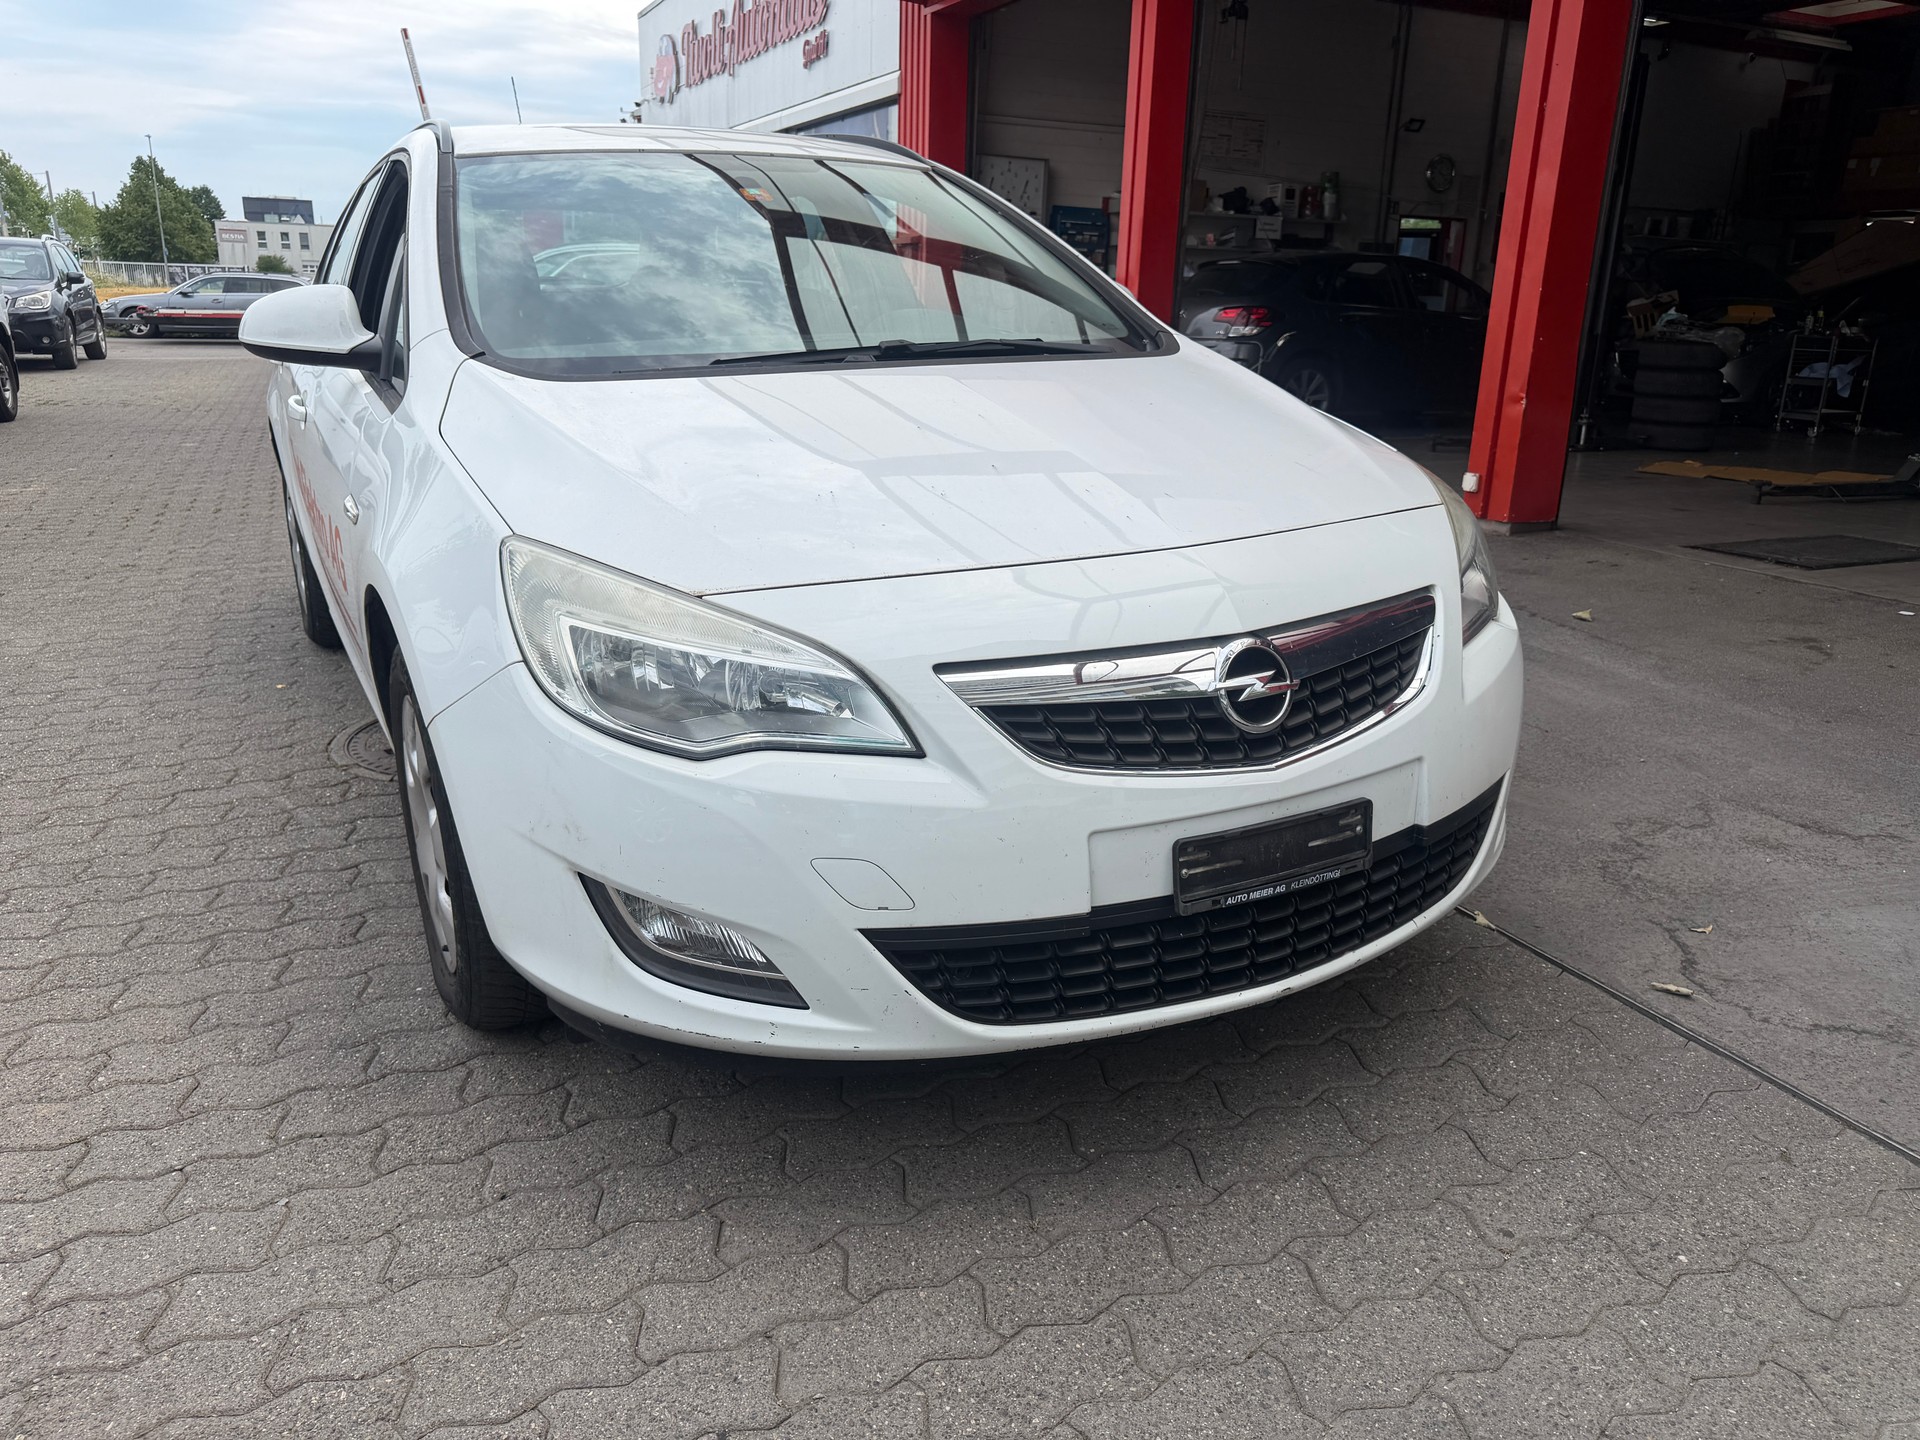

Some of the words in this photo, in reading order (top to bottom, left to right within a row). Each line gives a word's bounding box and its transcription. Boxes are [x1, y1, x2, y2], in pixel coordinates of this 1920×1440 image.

[1226, 893, 1248, 905] AUTO
[1249, 887, 1274, 900] MEIER
[1274, 884, 1286, 894] AG
